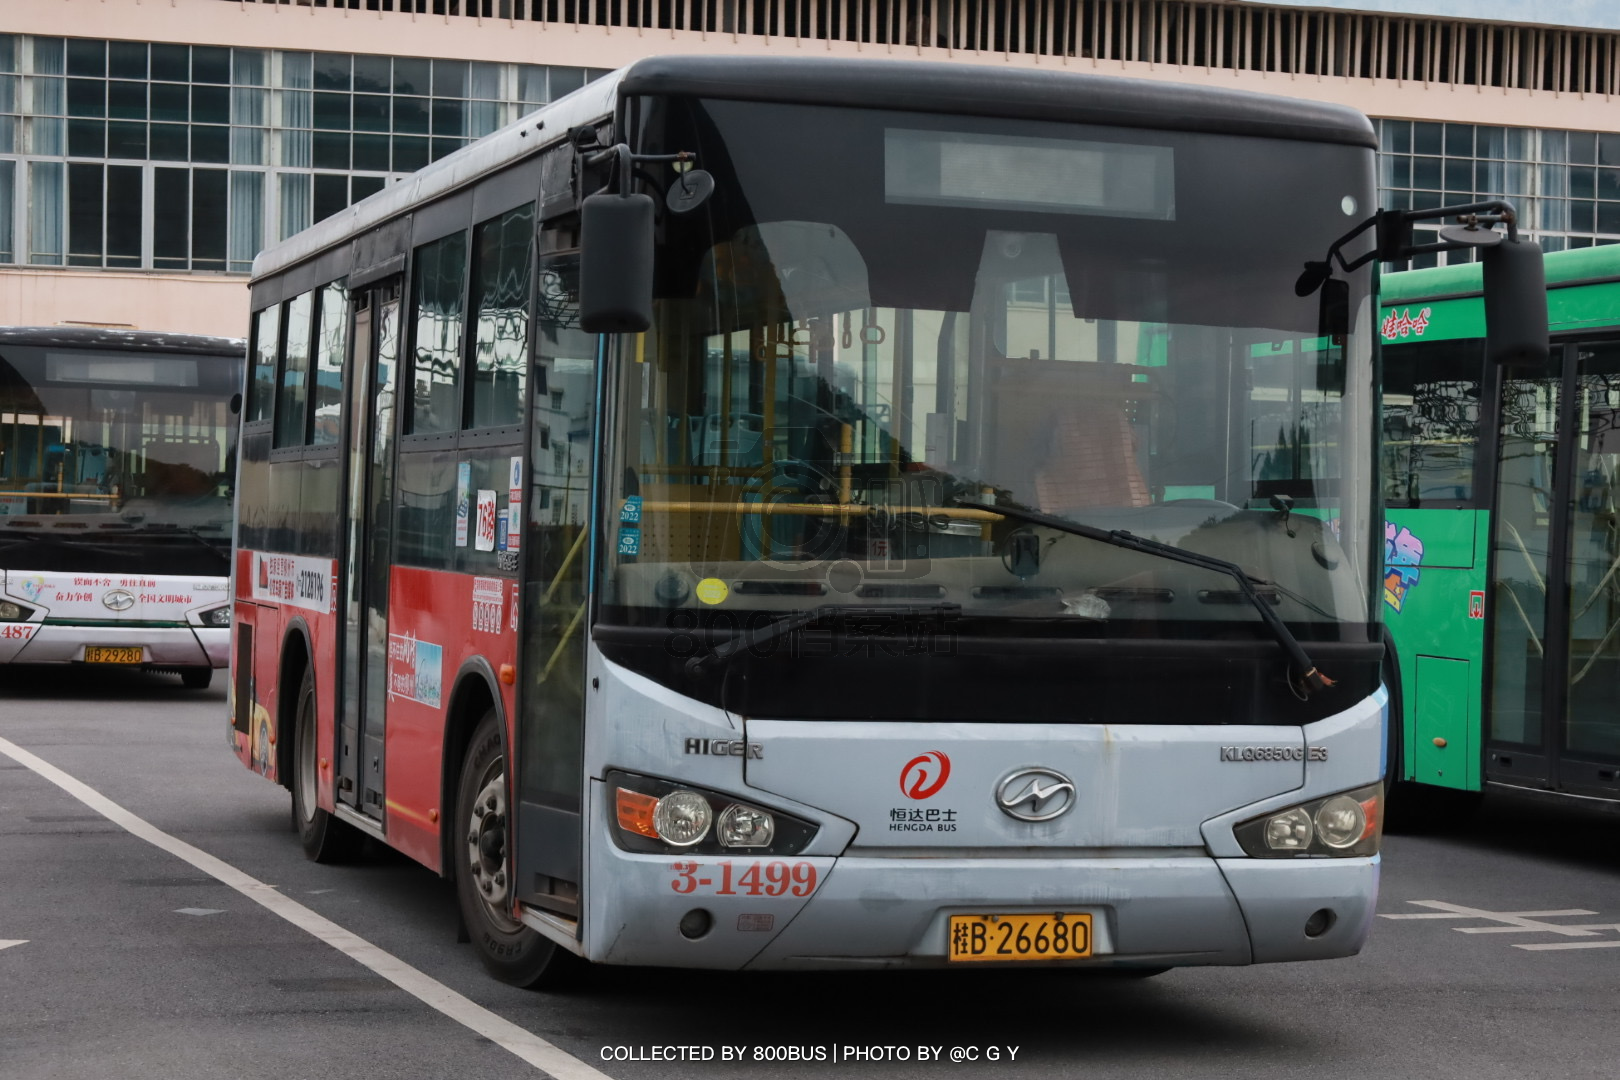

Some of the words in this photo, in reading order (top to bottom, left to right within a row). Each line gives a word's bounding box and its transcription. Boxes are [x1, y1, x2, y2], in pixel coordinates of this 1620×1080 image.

[1381, 309, 1428, 338] 娃哈哈
[620, 511, 639, 521] 2022
[619, 544, 637, 554] 2022
[138, 594, 192, 604] 全国文明城市
[684, 738, 764, 760] HIGER
[889, 808, 957, 822] 恒达巴士
[889, 823, 933, 832] HENGDA
[937, 823, 957, 832] BUS
[671, 860, 817, 897] 3-1499
[953, 921, 1088, 955] 桂B·26680
